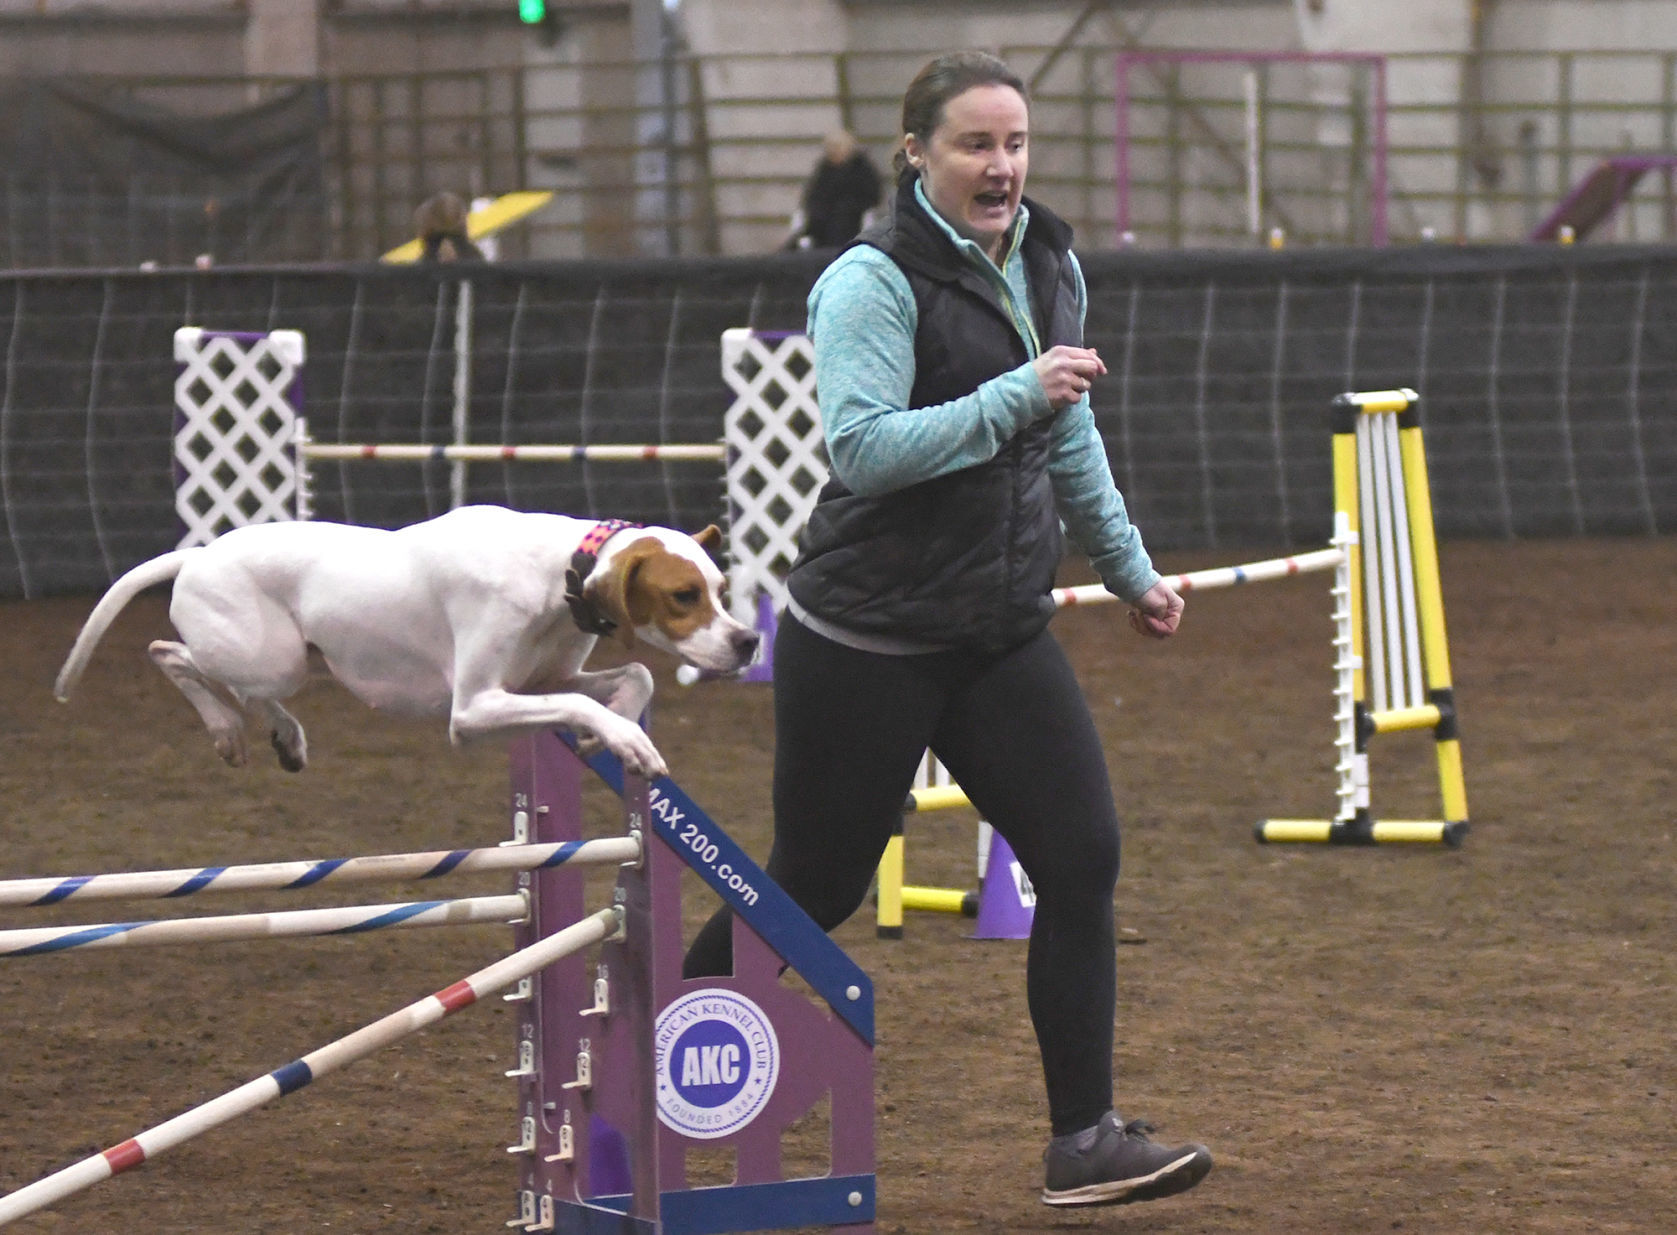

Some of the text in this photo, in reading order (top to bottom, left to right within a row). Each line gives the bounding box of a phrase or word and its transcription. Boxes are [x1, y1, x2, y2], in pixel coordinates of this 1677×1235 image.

[679, 823, 759, 906] 200.com
[702, 1003, 754, 1032] KENNEL
[751, 1031, 768, 1069] CLUB
[681, 1043, 741, 1087] AKC
[667, 1098, 723, 1125] FOUNDED
